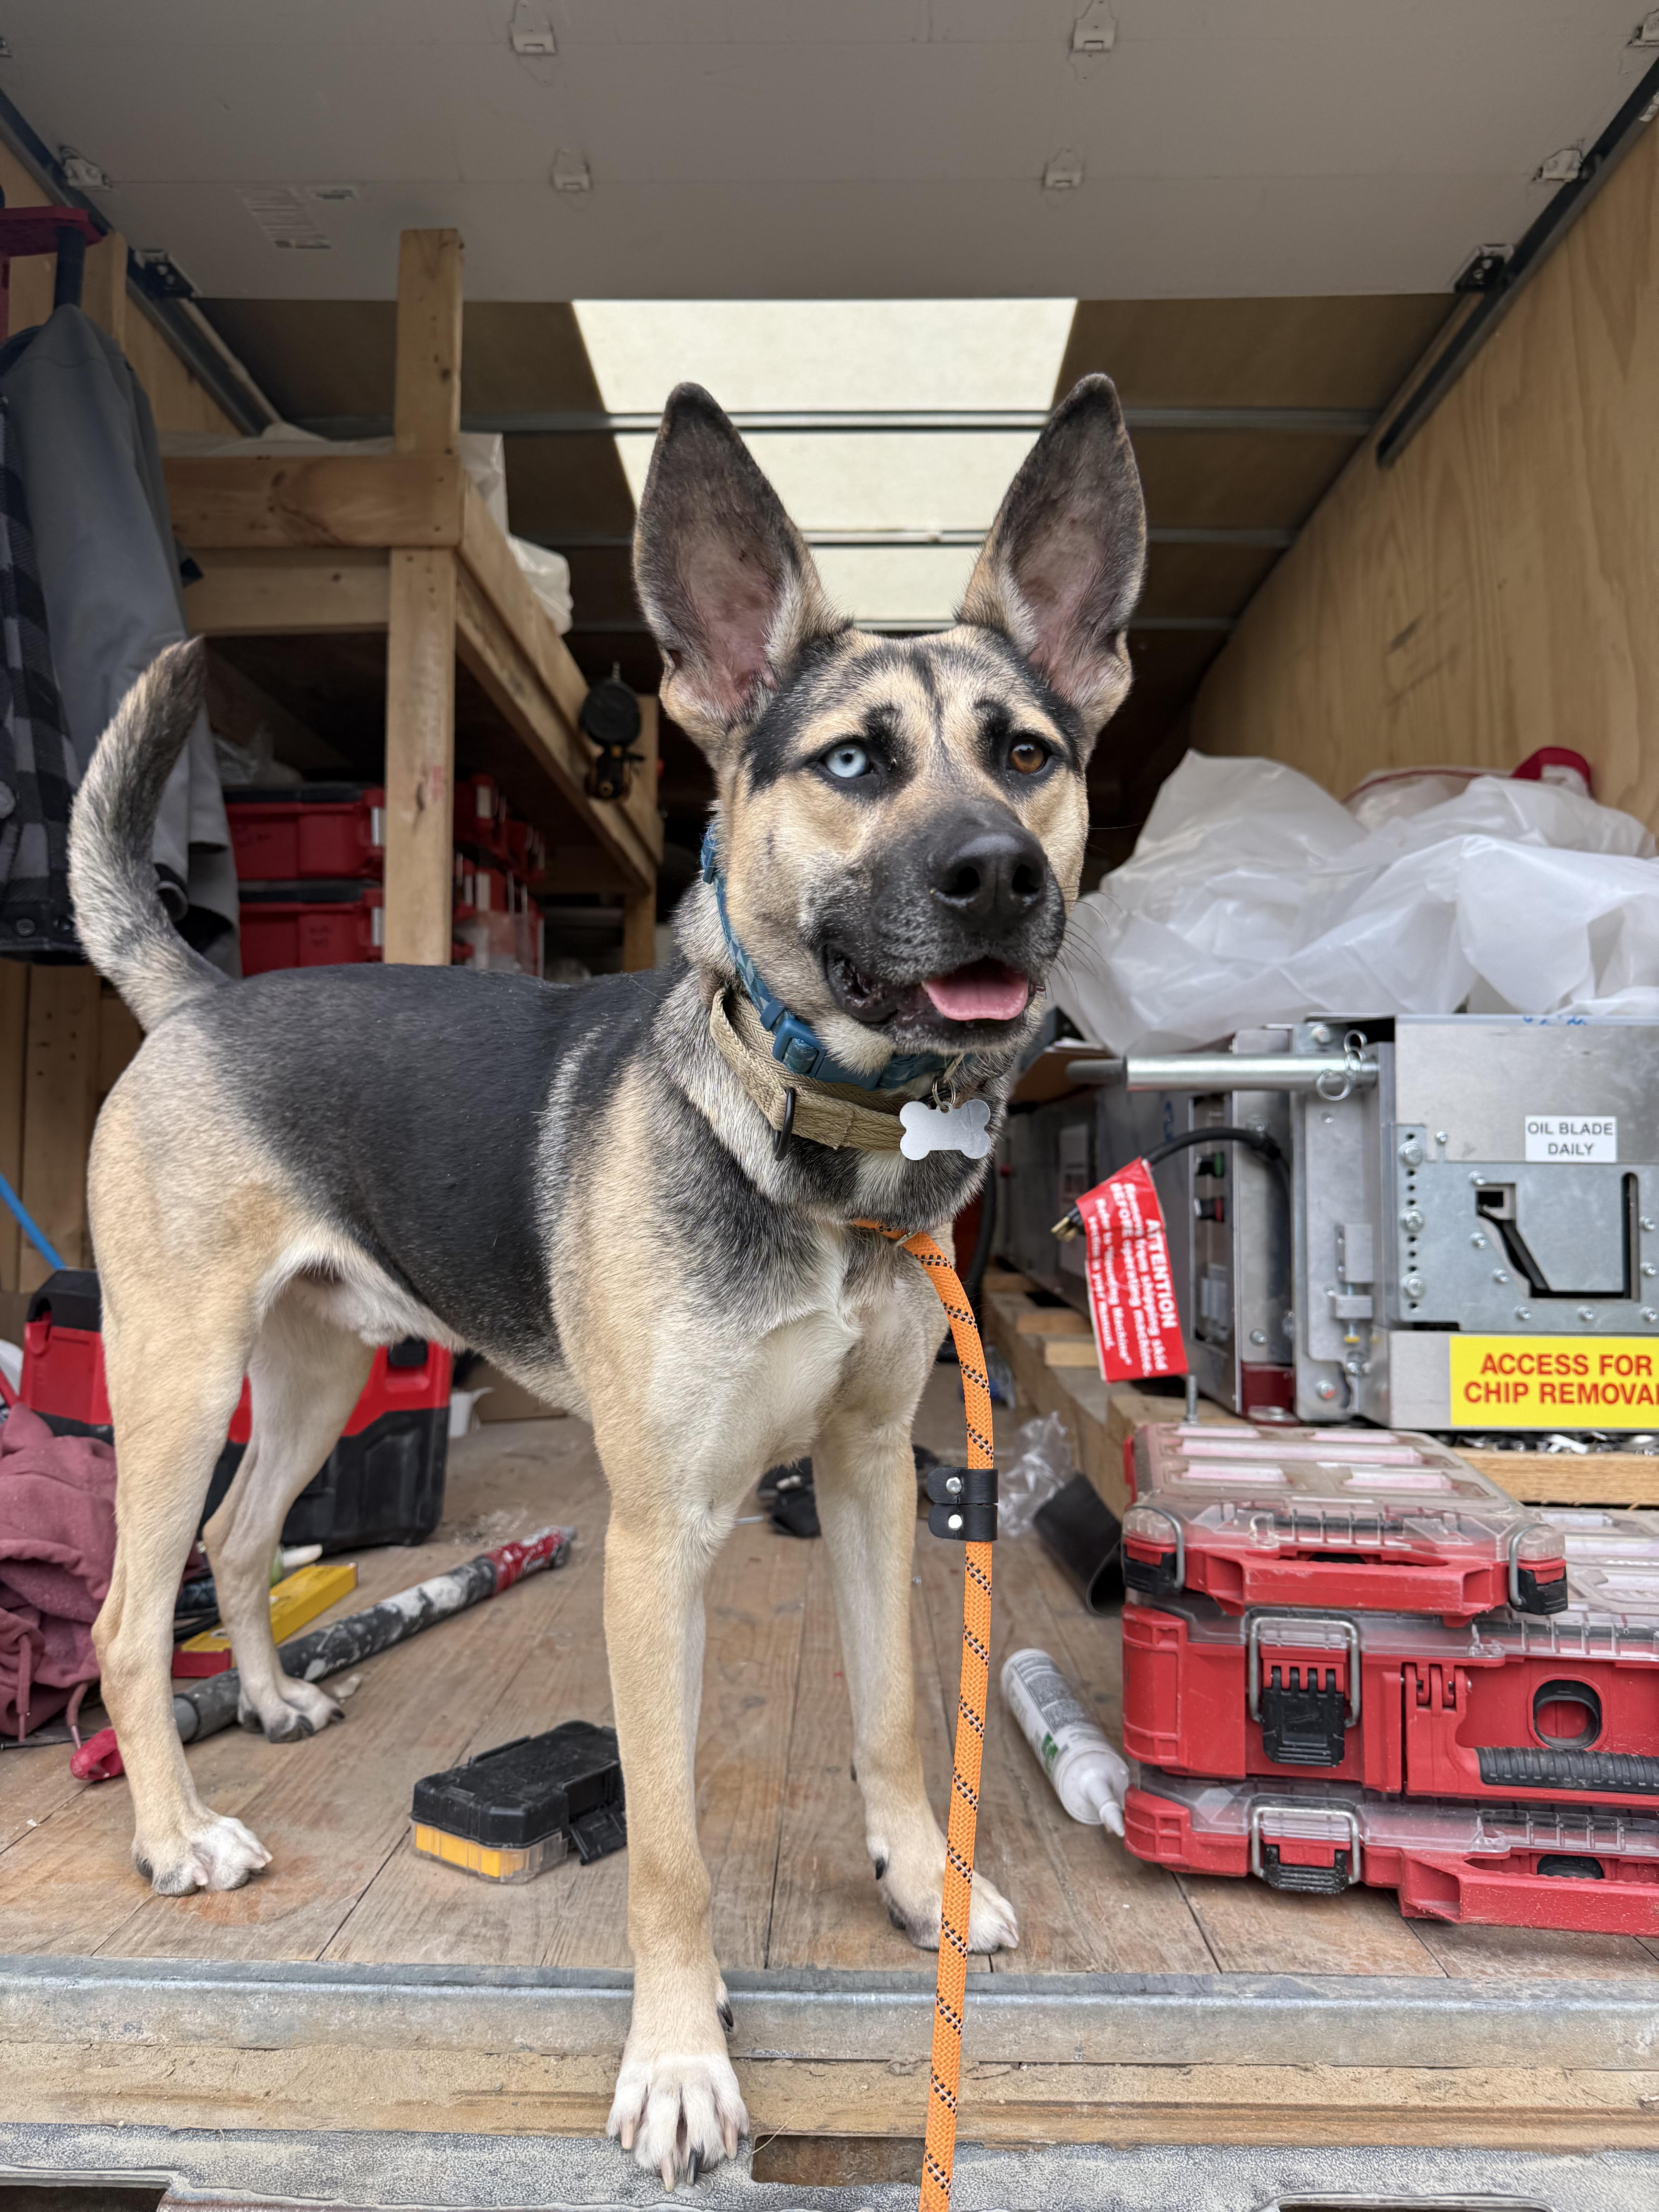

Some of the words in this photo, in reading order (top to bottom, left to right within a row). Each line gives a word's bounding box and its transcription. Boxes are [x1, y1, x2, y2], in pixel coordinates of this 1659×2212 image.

[1528, 1122, 1553, 1135] OIL
[1559, 1122, 1613, 1135] BLADE
[1548, 1142, 1593, 1156] DAILY
[1095, 1198, 1110, 1230] Refer
[1103, 1232, 1112, 1245] to
[1124, 1183, 1144, 1237] Remove
[1088, 1217, 1101, 1257] section
[1109, 1182, 1133, 1237] BEFORE
[1121, 1239, 1141, 1307] operating
[1135, 1238, 1148, 1272] from
[1146, 1218, 1178, 1328] ATTENTION
[1141, 1275, 1160, 1337] shipping
[1152, 1339, 1168, 1370] skid
[1480, 1353, 1589, 1376] ACCESS
[1599, 1354, 1652, 1376] FOR
[1463, 1381, 1528, 1403] CHIP
